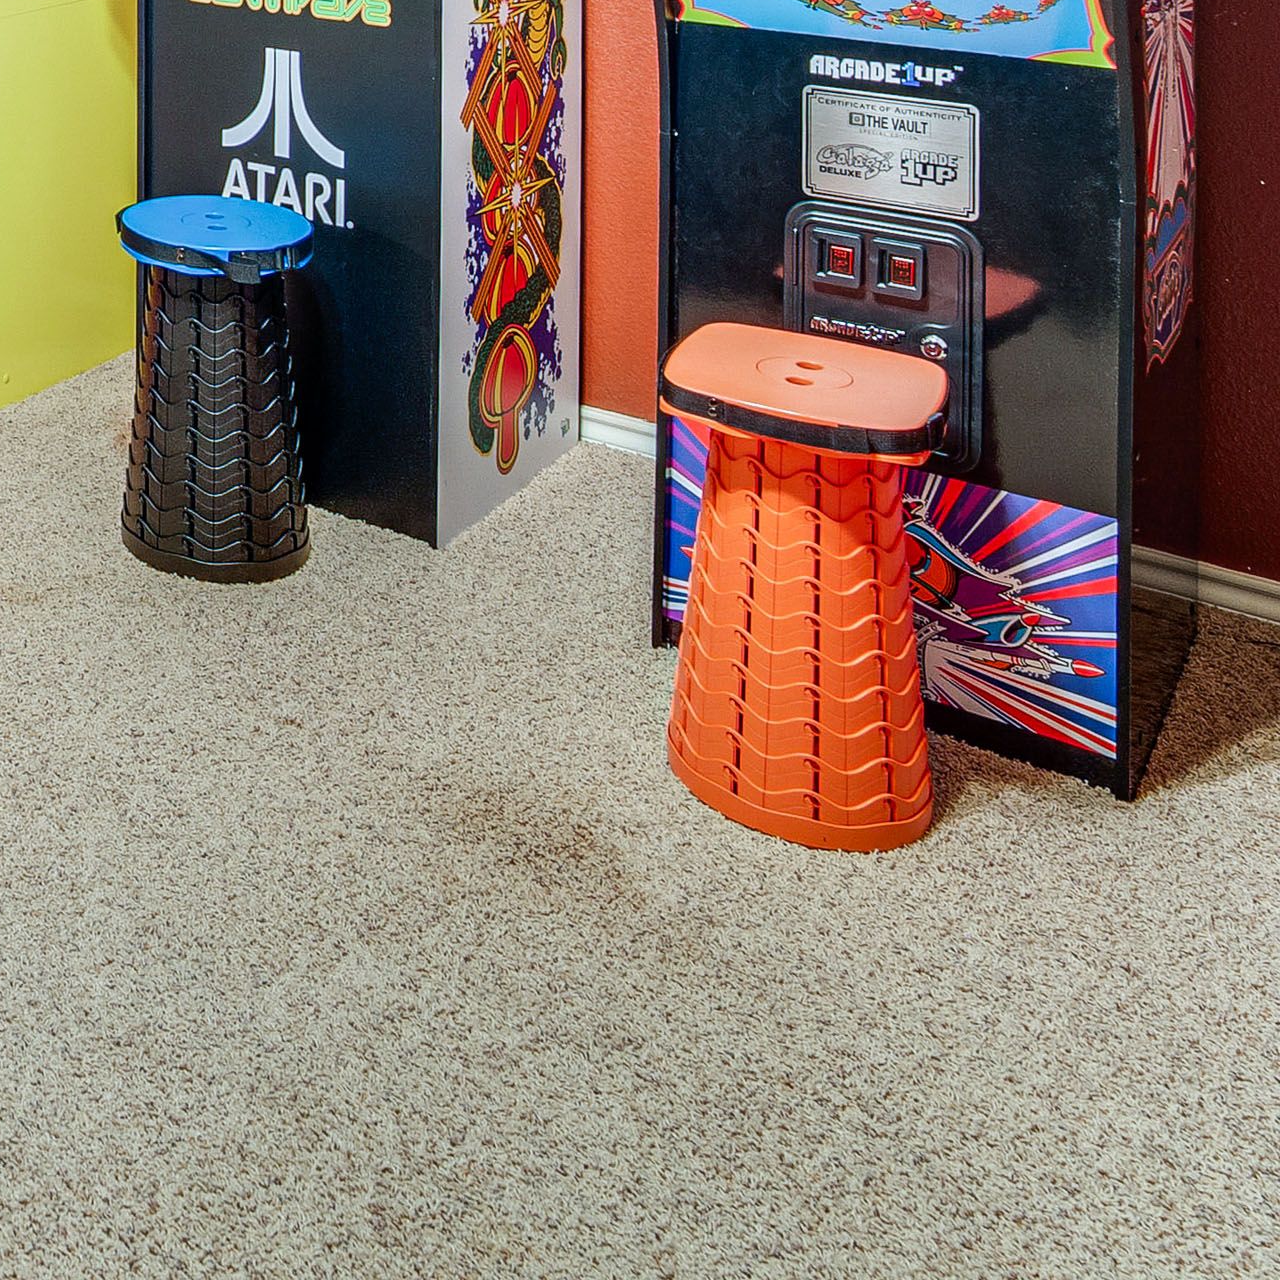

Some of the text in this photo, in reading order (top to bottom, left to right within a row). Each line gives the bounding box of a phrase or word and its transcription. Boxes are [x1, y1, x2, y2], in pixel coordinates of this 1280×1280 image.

[817, 96, 962, 121] CERTIFICATE OF AUTHENTICITY
[866, 114, 928, 134] THE VAULT
[816, 144, 894, 180] Galaga
[901, 148, 959, 168] ARCADE
[819, 165, 862, 178] DELUXE
